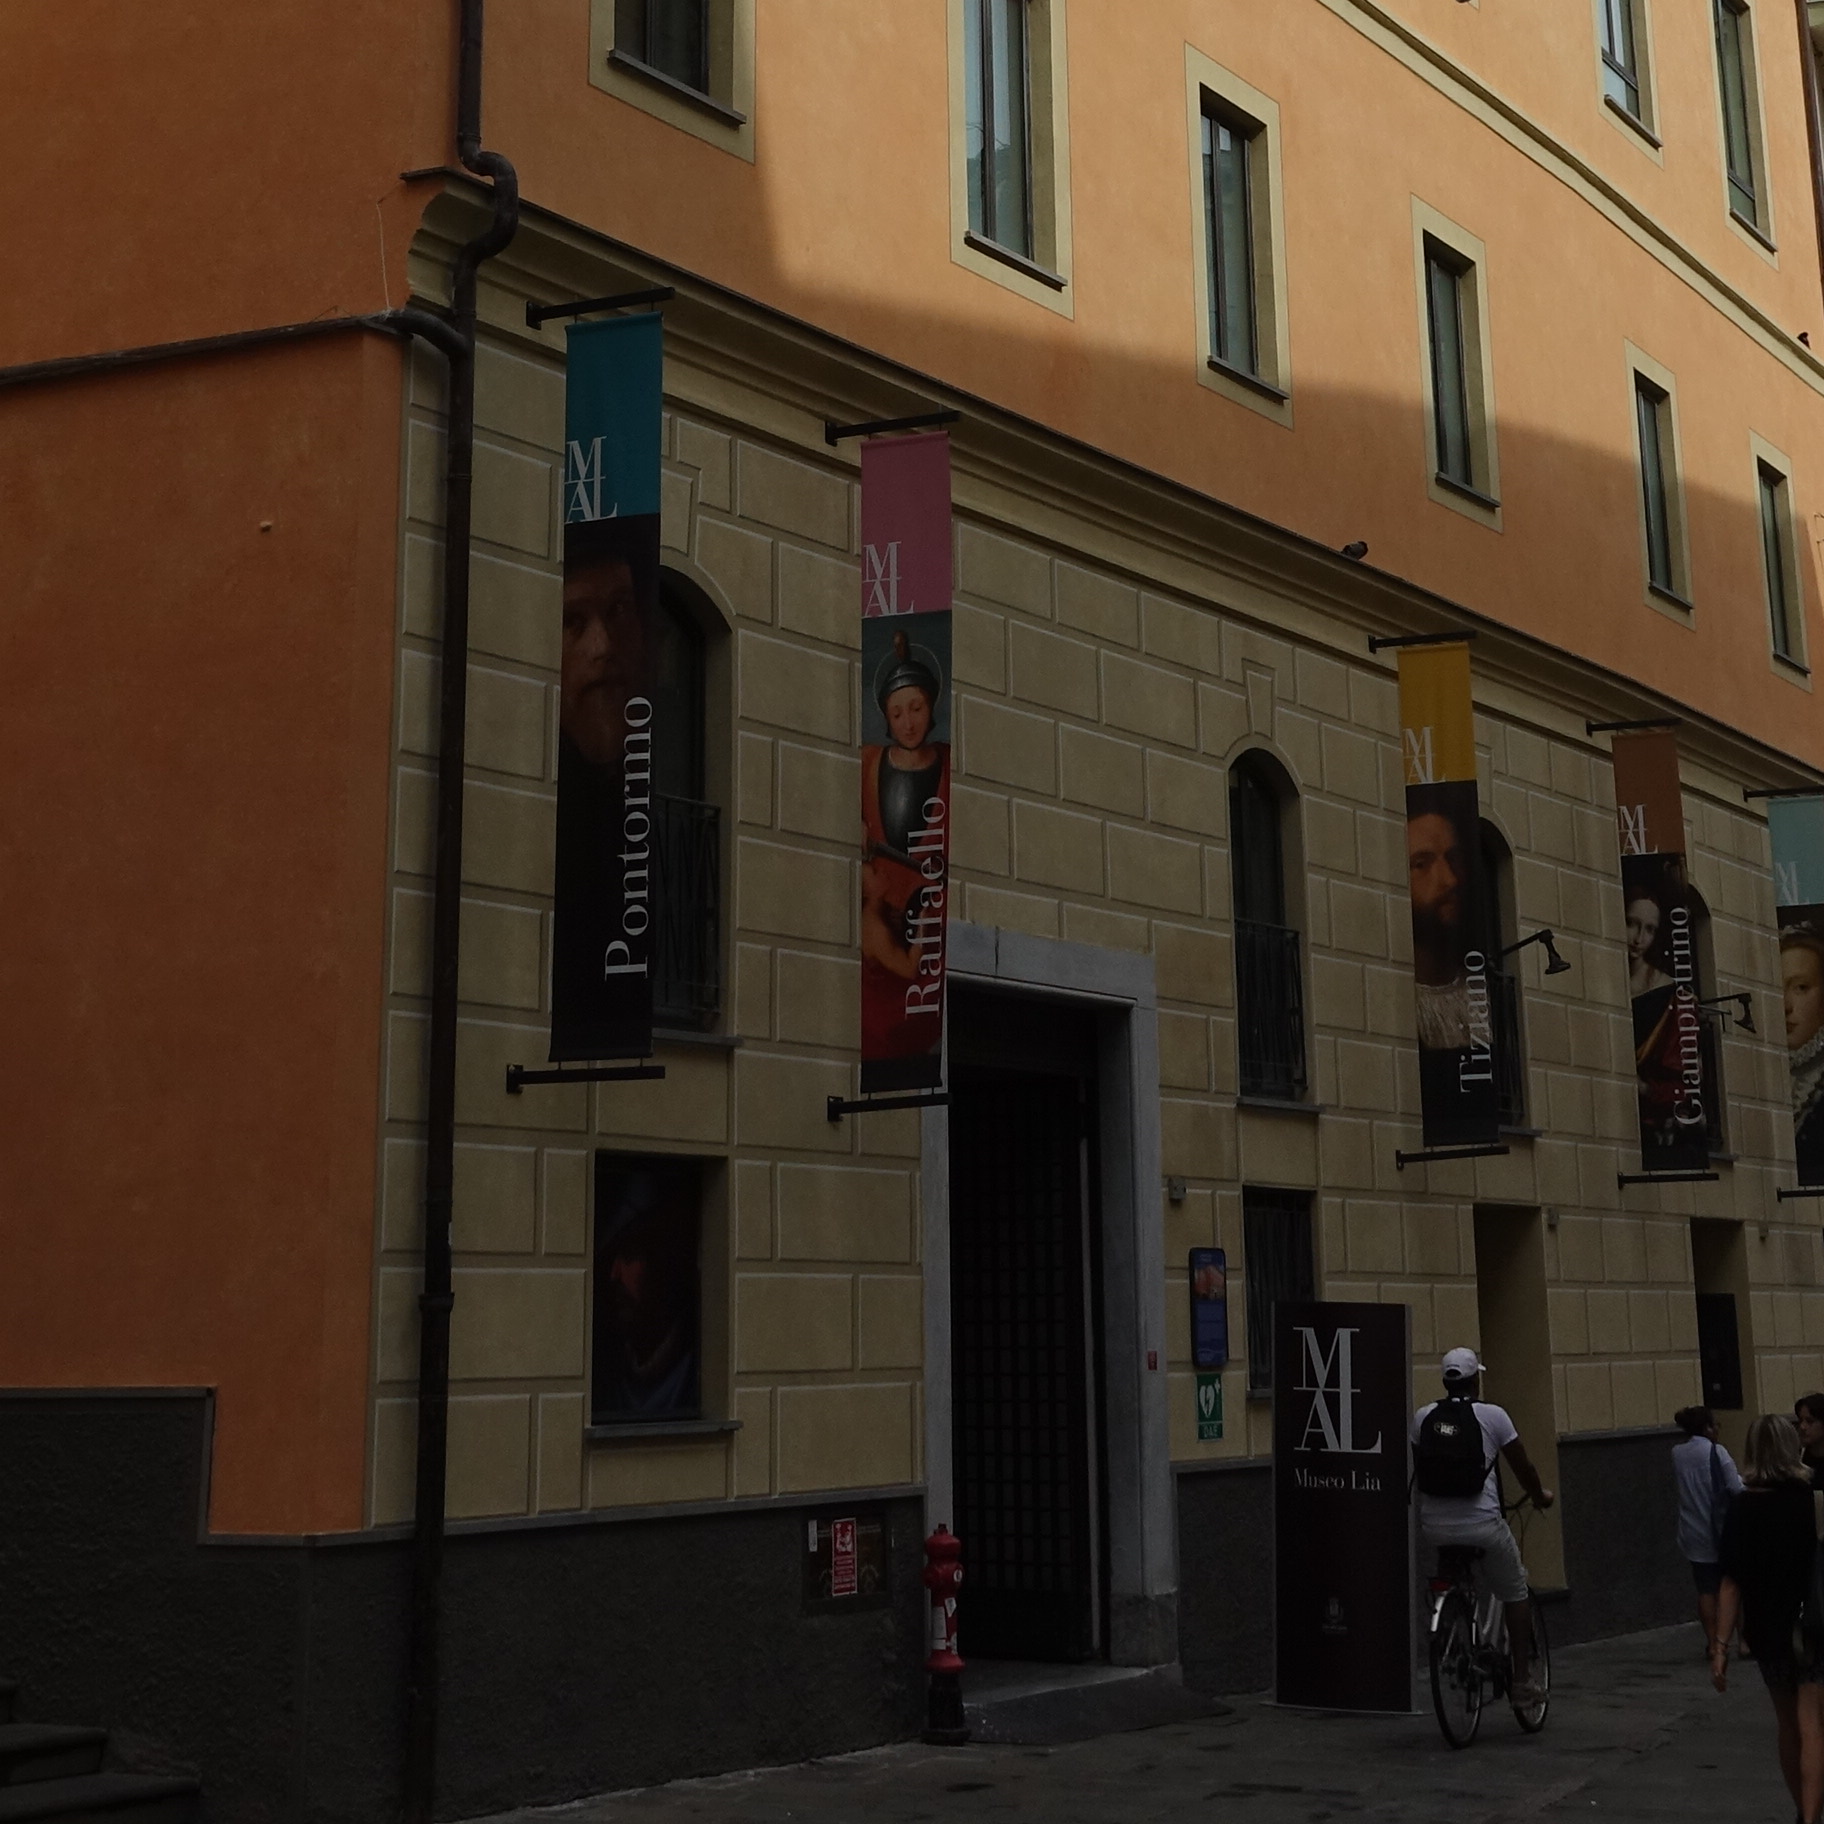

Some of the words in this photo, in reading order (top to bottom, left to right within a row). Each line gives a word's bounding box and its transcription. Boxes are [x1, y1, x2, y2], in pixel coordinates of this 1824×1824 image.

[603, 695, 655, 981] Pontormo
[904, 794, 949, 1021] Raffaello
[1458, 948, 1494, 1094] Tiziano
[1672, 904, 1708, 1128] Giampietrino
[1293, 1467, 1345, 1489] Museo
[1350, 1469, 1382, 1492] Lia
